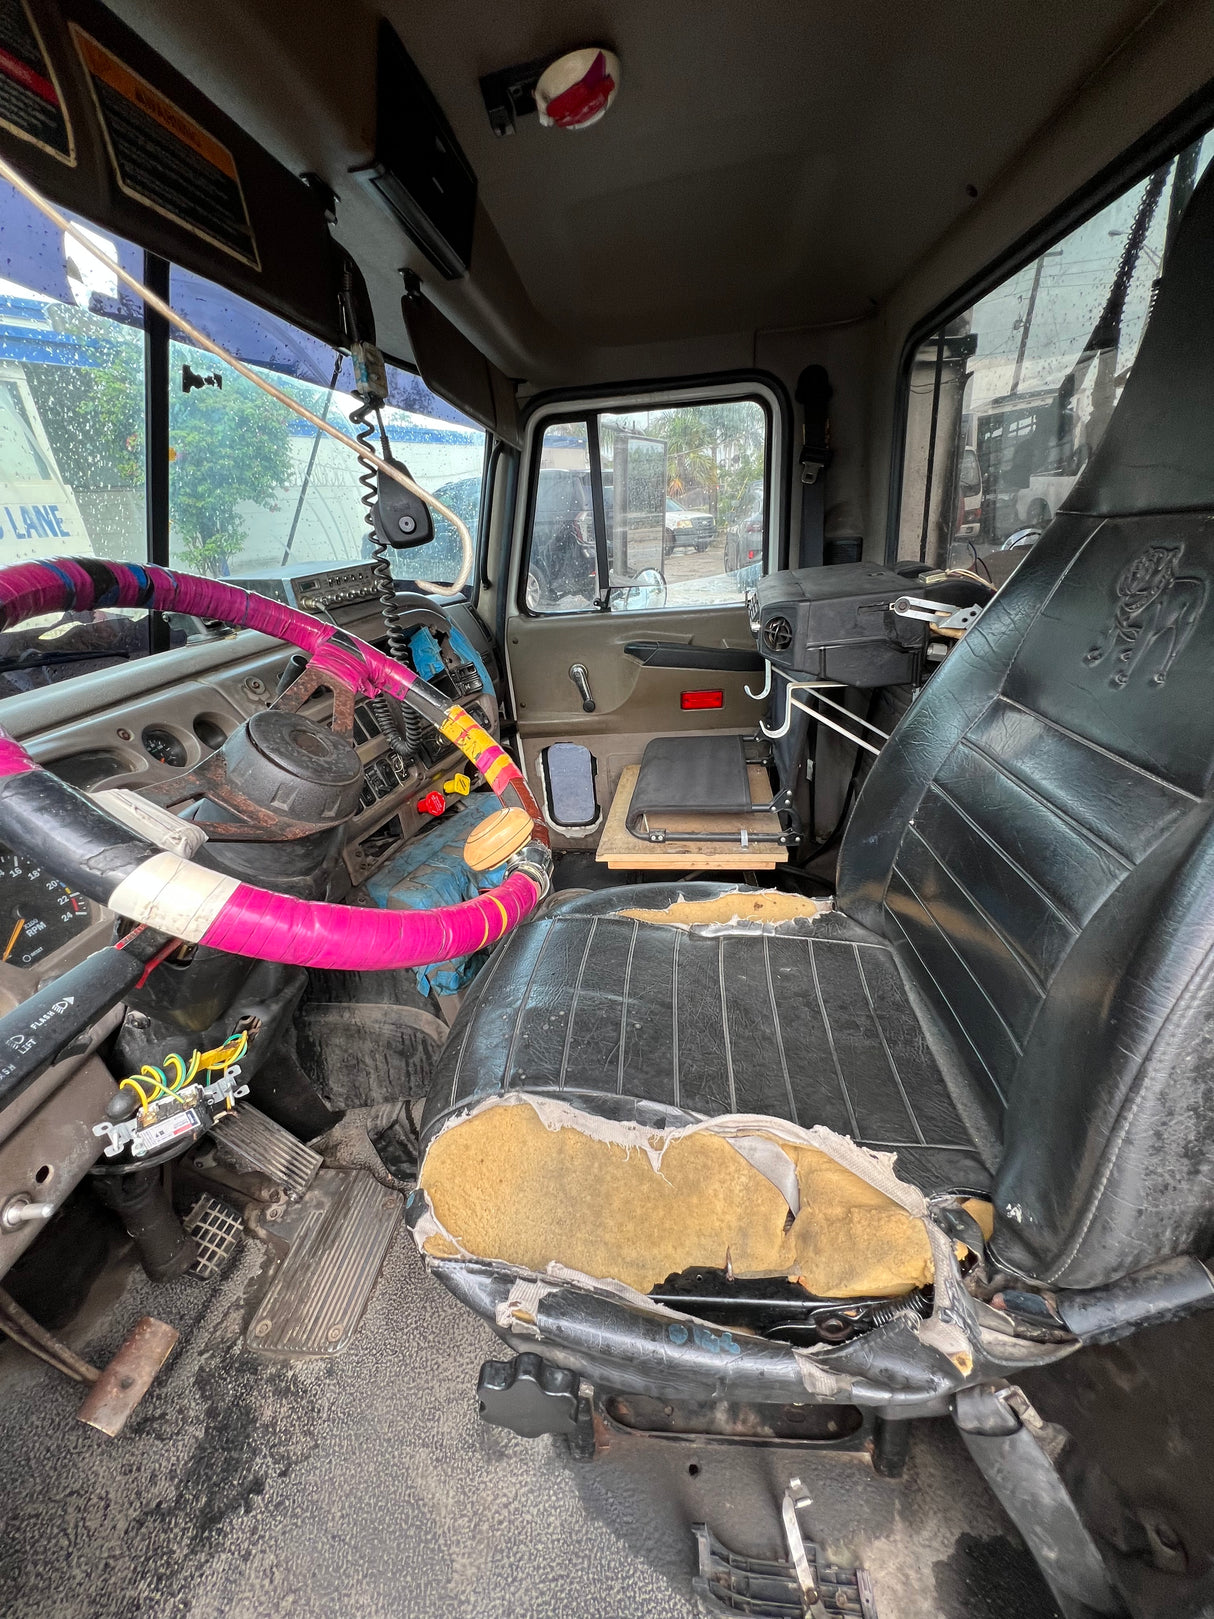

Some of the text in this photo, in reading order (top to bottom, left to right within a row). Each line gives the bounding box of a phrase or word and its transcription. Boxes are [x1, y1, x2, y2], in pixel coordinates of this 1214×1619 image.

[4, 505, 71, 539] LANE
[9, 867, 22, 878] 16
[27, 870, 40, 880] 18
[46, 880, 58, 891] 20
[57, 895, 70, 905] 22
[61, 911, 73, 922] 24
[25, 921, 47, 938] RPM
[30, 1010, 55, 1030] FLASH
[18, 1038, 37, 1055] LIFT
